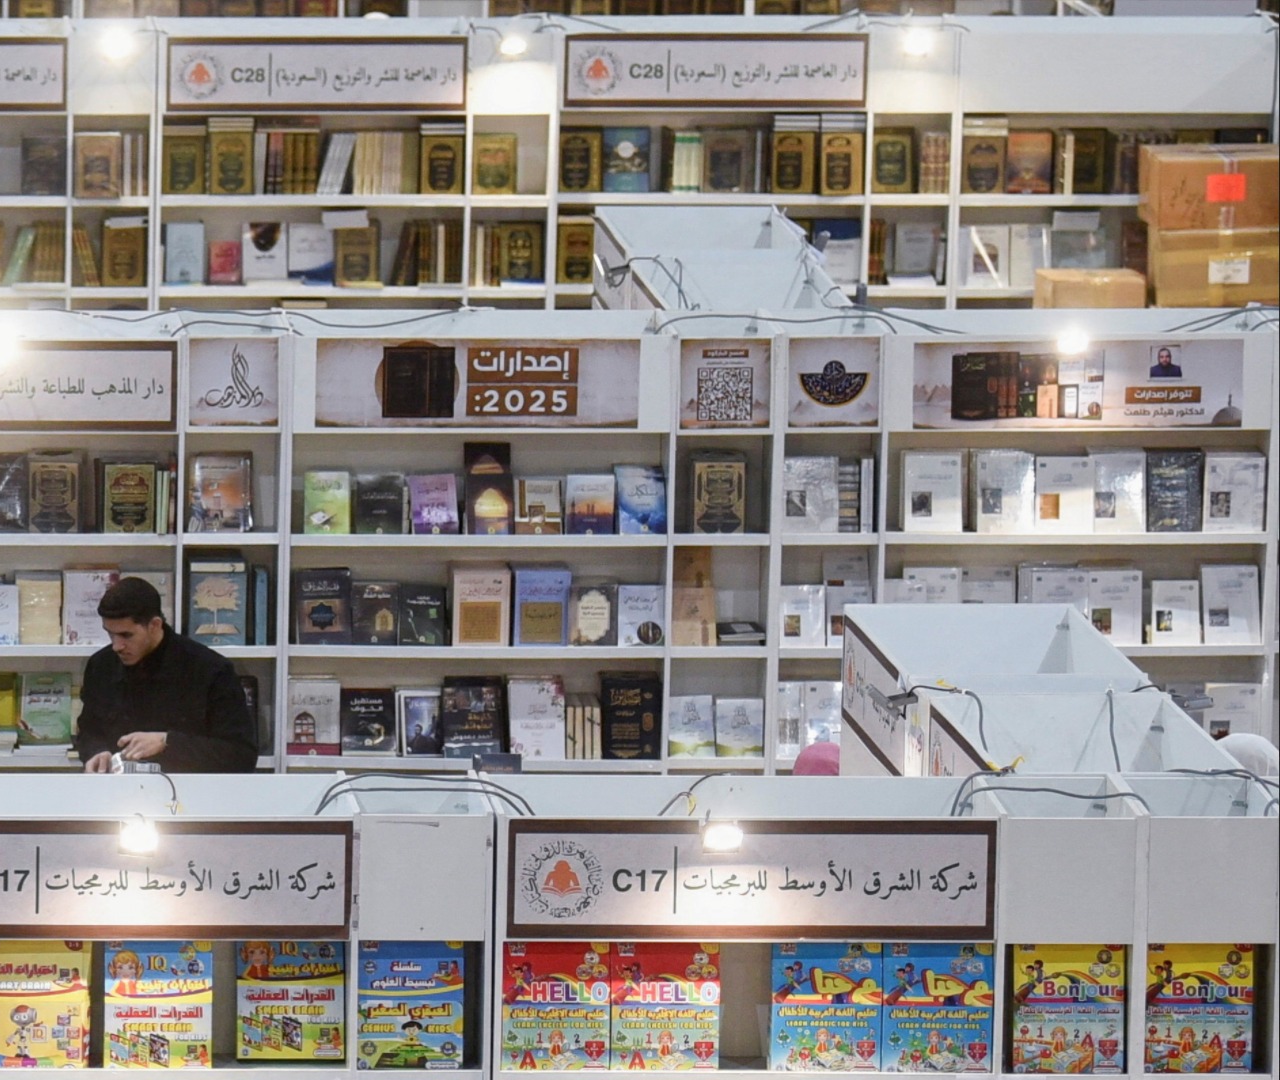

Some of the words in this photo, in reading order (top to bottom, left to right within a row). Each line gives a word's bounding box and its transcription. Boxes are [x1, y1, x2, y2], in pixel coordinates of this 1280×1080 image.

[41, 72, 56, 85] دار
[231, 68, 264, 83] C28
[276, 68, 327, 87] (السعودية)
[333, 68, 371, 91] والتوزيع
[375, 68, 399, 86] للنشر
[441, 71, 456, 85] دار
[630, 65, 663, 79] C28
[674, 65, 726, 84] (السعودية)
[733, 65, 770, 87] والتوزيع
[775, 65, 799, 83] للنشر
[842, 67, 857, 82] دار
[474, 349, 569, 379] إصدارات
[42, 375, 85, 395] للطباعة
[92, 374, 137, 397] المذهب
[141, 380, 164, 399] دار
[1134, 387, 1165, 400] إصدارات
[1168, 388, 1192, 399] تتوفر
[1124, 407, 1150, 417] طلعت
[1152, 407, 1173, 418] هيثم
[1176, 406, 1204, 417] الدكتور
[46, 866, 129, 897] للبرمجيات
[140, 860, 211, 897] الأوسط
[224, 868, 279, 899] الشرق
[291, 862, 335, 899] شركة
[613, 869, 667, 891] C17
[683, 866, 768, 897] للبرمجيات
[778, 860, 851, 897] الأوسط
[862, 868, 921, 900] الشرق
[932, 862, 977, 900] شركة
[531, 981, 608, 1003] HELLO
[641, 981, 717, 1002] HELLO
[1043, 980, 1118, 1000] Bonjour
[1172, 980, 1248, 1001] Bonjour
